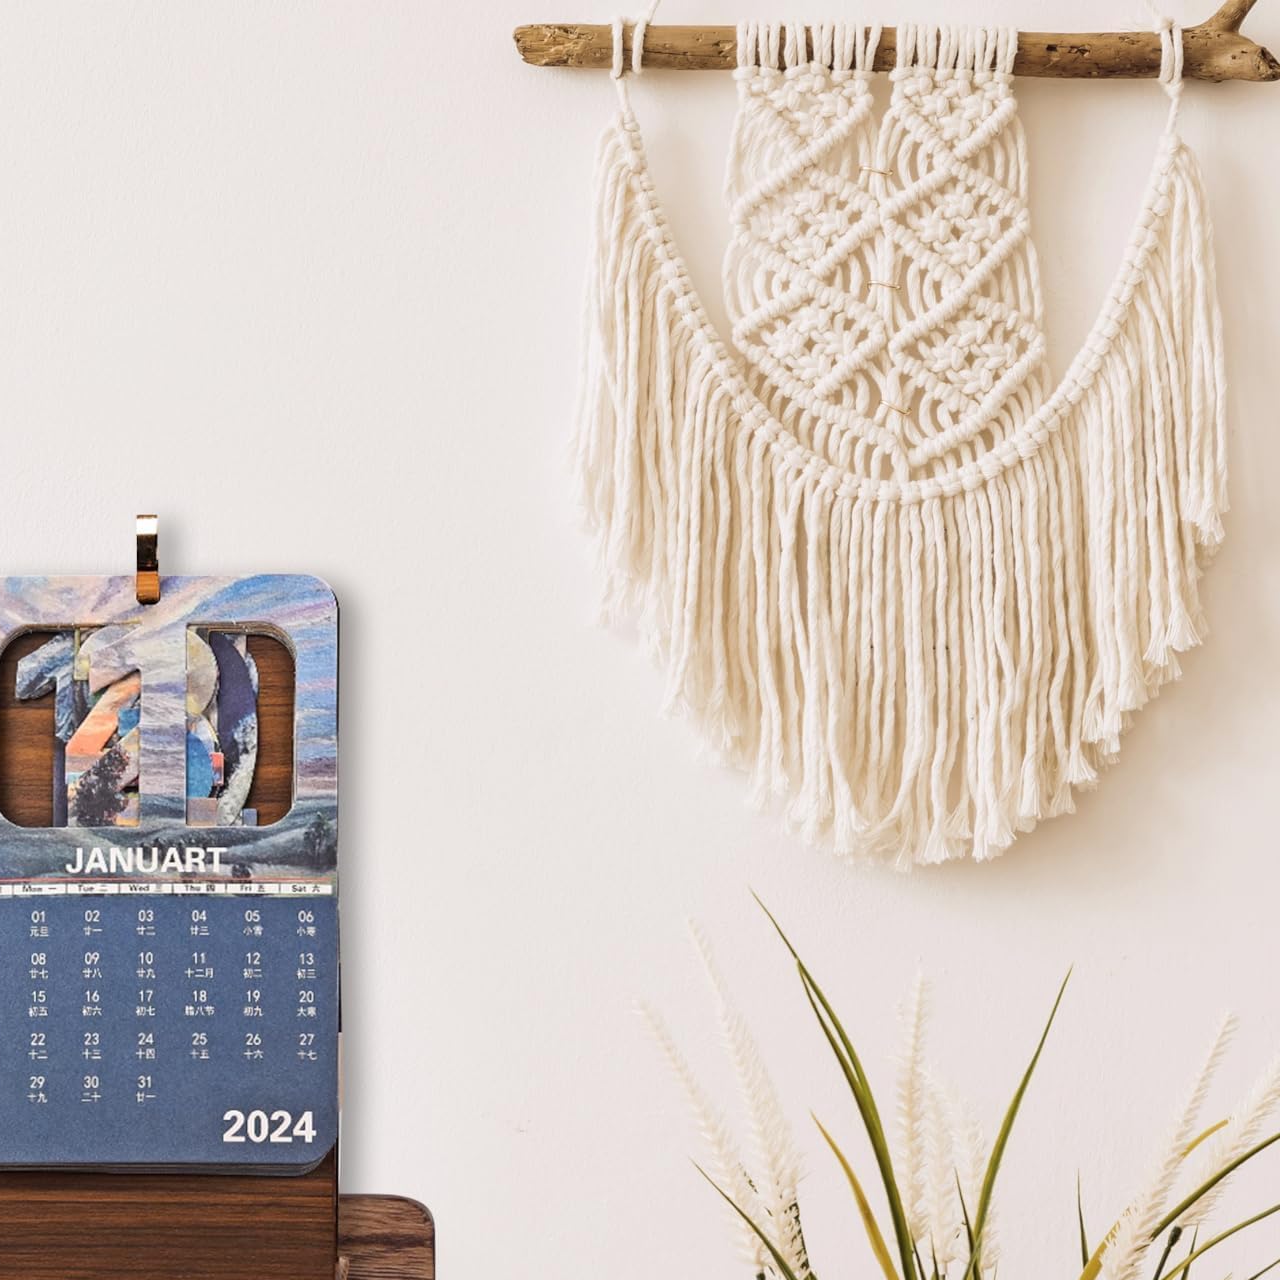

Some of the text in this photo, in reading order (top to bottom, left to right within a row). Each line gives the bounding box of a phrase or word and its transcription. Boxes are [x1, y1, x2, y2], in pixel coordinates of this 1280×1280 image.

[65, 847, 228, 874] JANUART
[77, 884, 94, 892] Tue
[129, 884, 150, 892] Wed
[291, 884, 307, 893] Sat
[31, 910, 314, 923] 01 02 03 04 05 06
[29, 926, 49, 937] 元旦
[83, 926, 102, 936] 廿一
[136, 925, 155, 936] 廿二
[190, 925, 210, 936] 廿三
[31, 953, 46, 965] 08
[85, 952, 99, 965] 09
[139, 952, 153, 965] 10
[192, 952, 206, 964] 11
[246, 952, 260, 965] 12
[299, 953, 314, 965] 13
[29, 968, 48, 979] 廿七
[82, 968, 102, 978] 廿八
[136, 968, 156, 979] 廿九
[184, 968, 213, 978] 十二月
[243, 968, 262, 978] 初二
[297, 968, 316, 979] 初三
[32, 990, 46, 1002] 15
[86, 990, 99, 1002] 16
[139, 989, 153, 1002] 17
[193, 990, 207, 1002] 18
[247, 990, 260, 1002] 19
[299, 990, 314, 1003] 20
[28, 1006, 48, 1017] 初五
[82, 1005, 102, 1016] 初六
[136, 1006, 155, 1016] 初七
[243, 1006, 264, 1016] 初九
[31, 1033, 45, 1046] 22
[84, 1032, 99, 1045] 23
[138, 1032, 154, 1045] 24
[192, 1032, 207, 1045] 25
[246, 1033, 261, 1045] 26
[299, 1033, 315, 1045] 27
[28, 1049, 48, 1059] 十二
[82, 1048, 101, 1059] 十三
[136, 1048, 155, 1059] 十四
[190, 1049, 210, 1059] 十五
[244, 1049, 263, 1059] 十六
[297, 1050, 317, 1060] 十七
[30, 1076, 45, 1088] 29
[84, 1076, 99, 1088] 30
[138, 1076, 151, 1088] 31
[27, 1092, 47, 1103] 十九
[81, 1092, 101, 1102] 二十
[136, 1092, 156, 1103] 廿一
[223, 1110, 317, 1143] 2024
